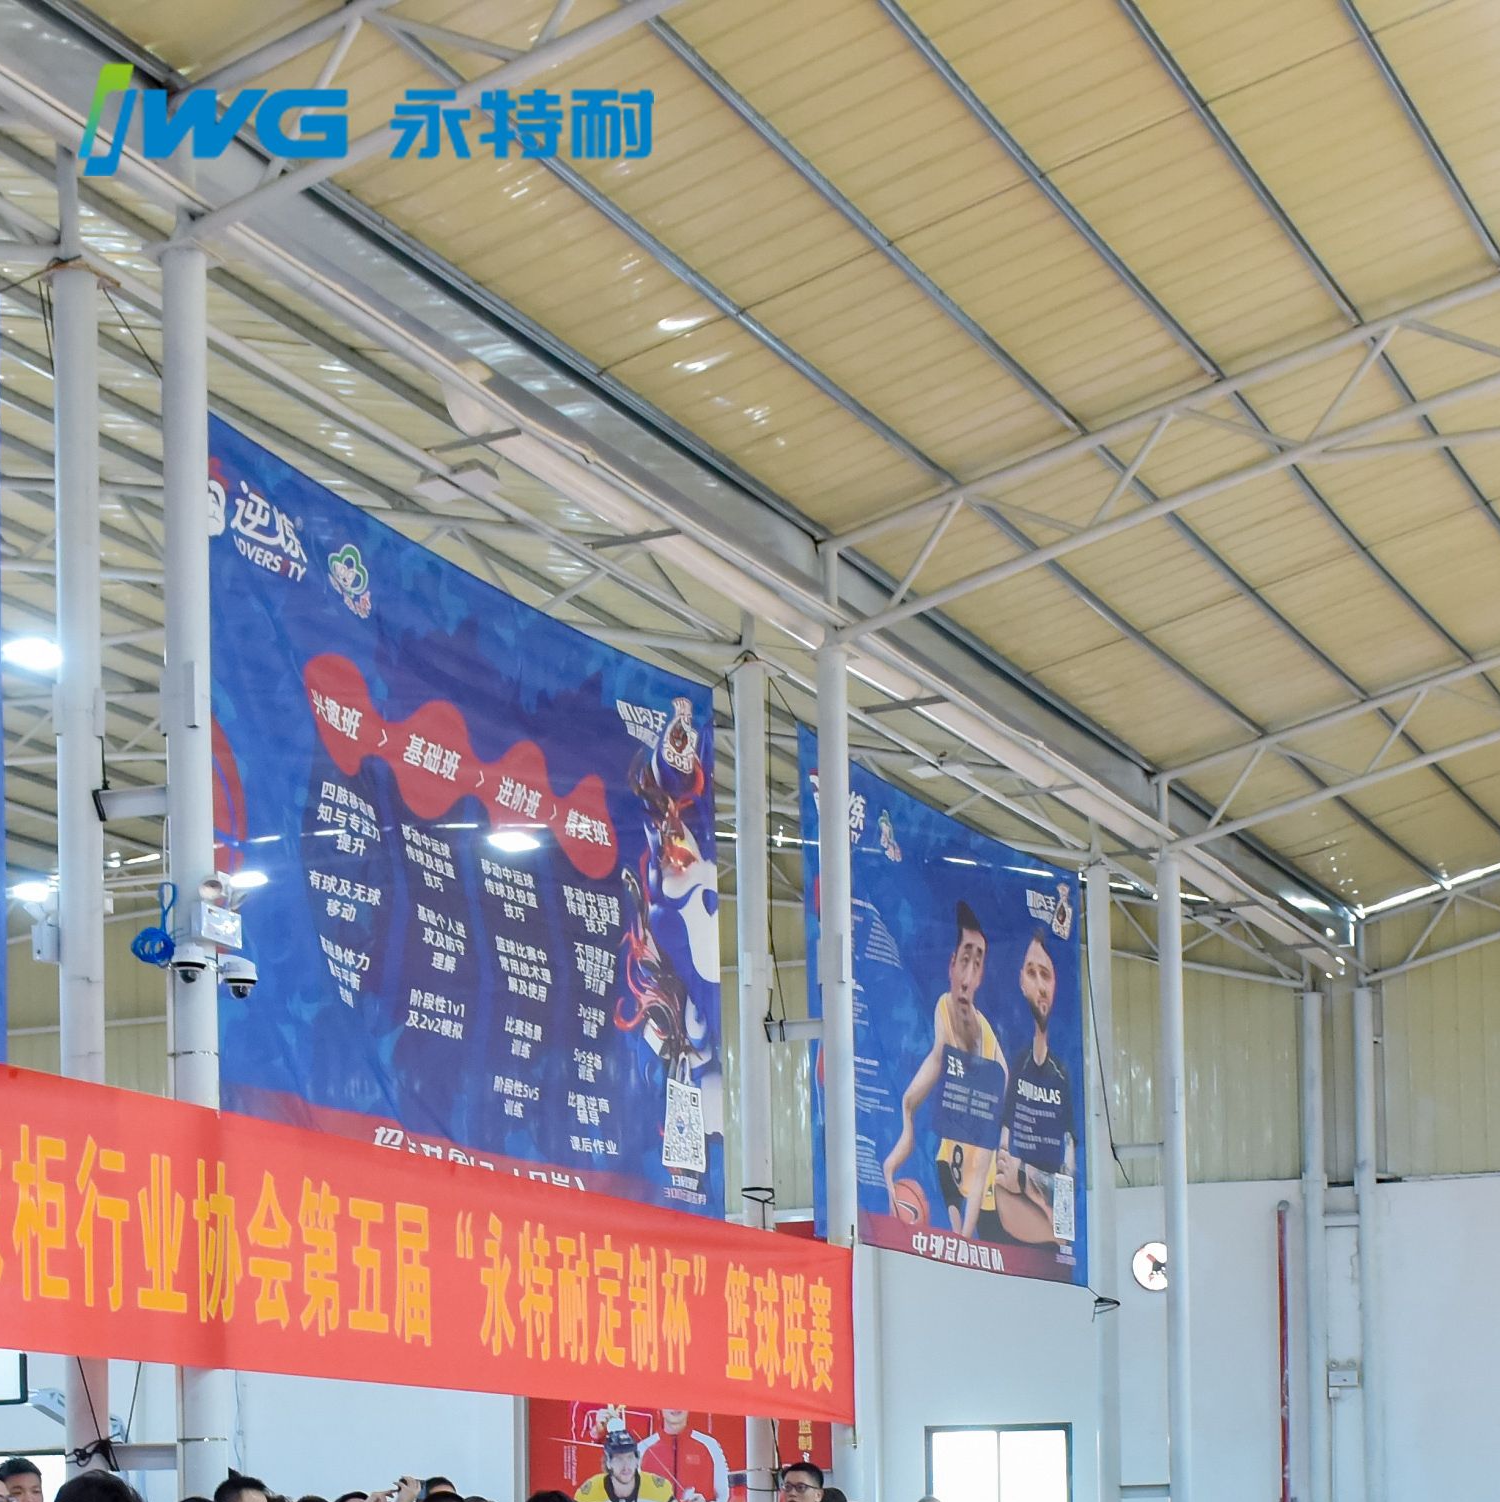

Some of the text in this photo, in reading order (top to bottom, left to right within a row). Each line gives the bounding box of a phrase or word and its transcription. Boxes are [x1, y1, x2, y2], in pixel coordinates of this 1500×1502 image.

[310, 688, 363, 741] 兴趣班
[403, 733, 462, 782] 基础班
[495, 776, 542, 819] 进阶班
[316, 803, 381, 842] 知与专注力
[564, 808, 612, 847] 精英班
[336, 834, 367, 857] 提升
[308, 870, 382, 906] 有球及无球
[325, 899, 357, 922] 移动
[409, 988, 465, 1017] 阶段性1v1
[405, 1010, 463, 1040] 及2v2模拟
[724, 1262, 834, 1393] 篮球联赛
